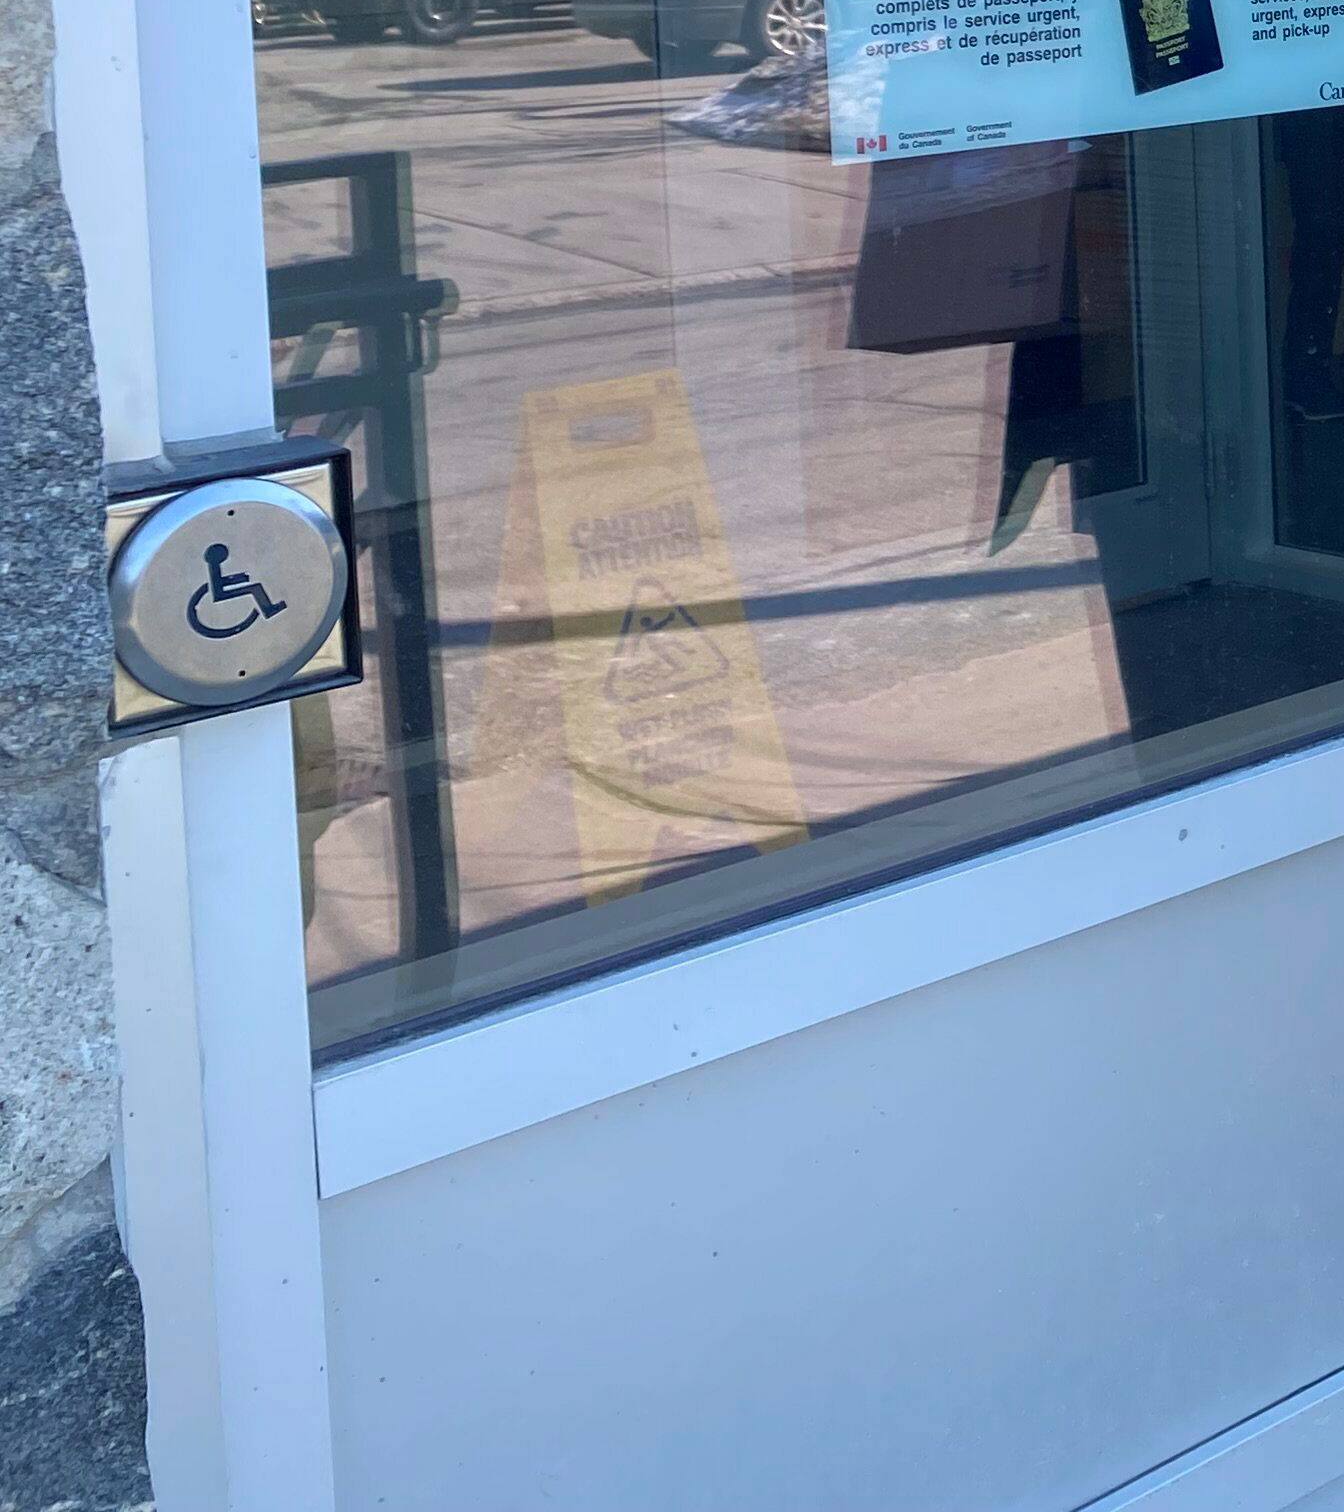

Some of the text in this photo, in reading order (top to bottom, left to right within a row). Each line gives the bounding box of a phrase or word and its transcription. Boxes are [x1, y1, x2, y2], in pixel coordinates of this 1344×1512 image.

[871, 6, 1081, 36] compris le service urgent,
[1251, 7, 1297, 24] urgent,
[1252, 23, 1330, 41] and pick-up
[865, 25, 1081, 59] express et de récupération
[980, 43, 1082, 67] de passeport
[898, 128, 955, 140] Gouvernement
[966, 121, 1012, 133] Government
[977, 131, 1006, 140] Canada
[912, 139, 942, 148] Canada
